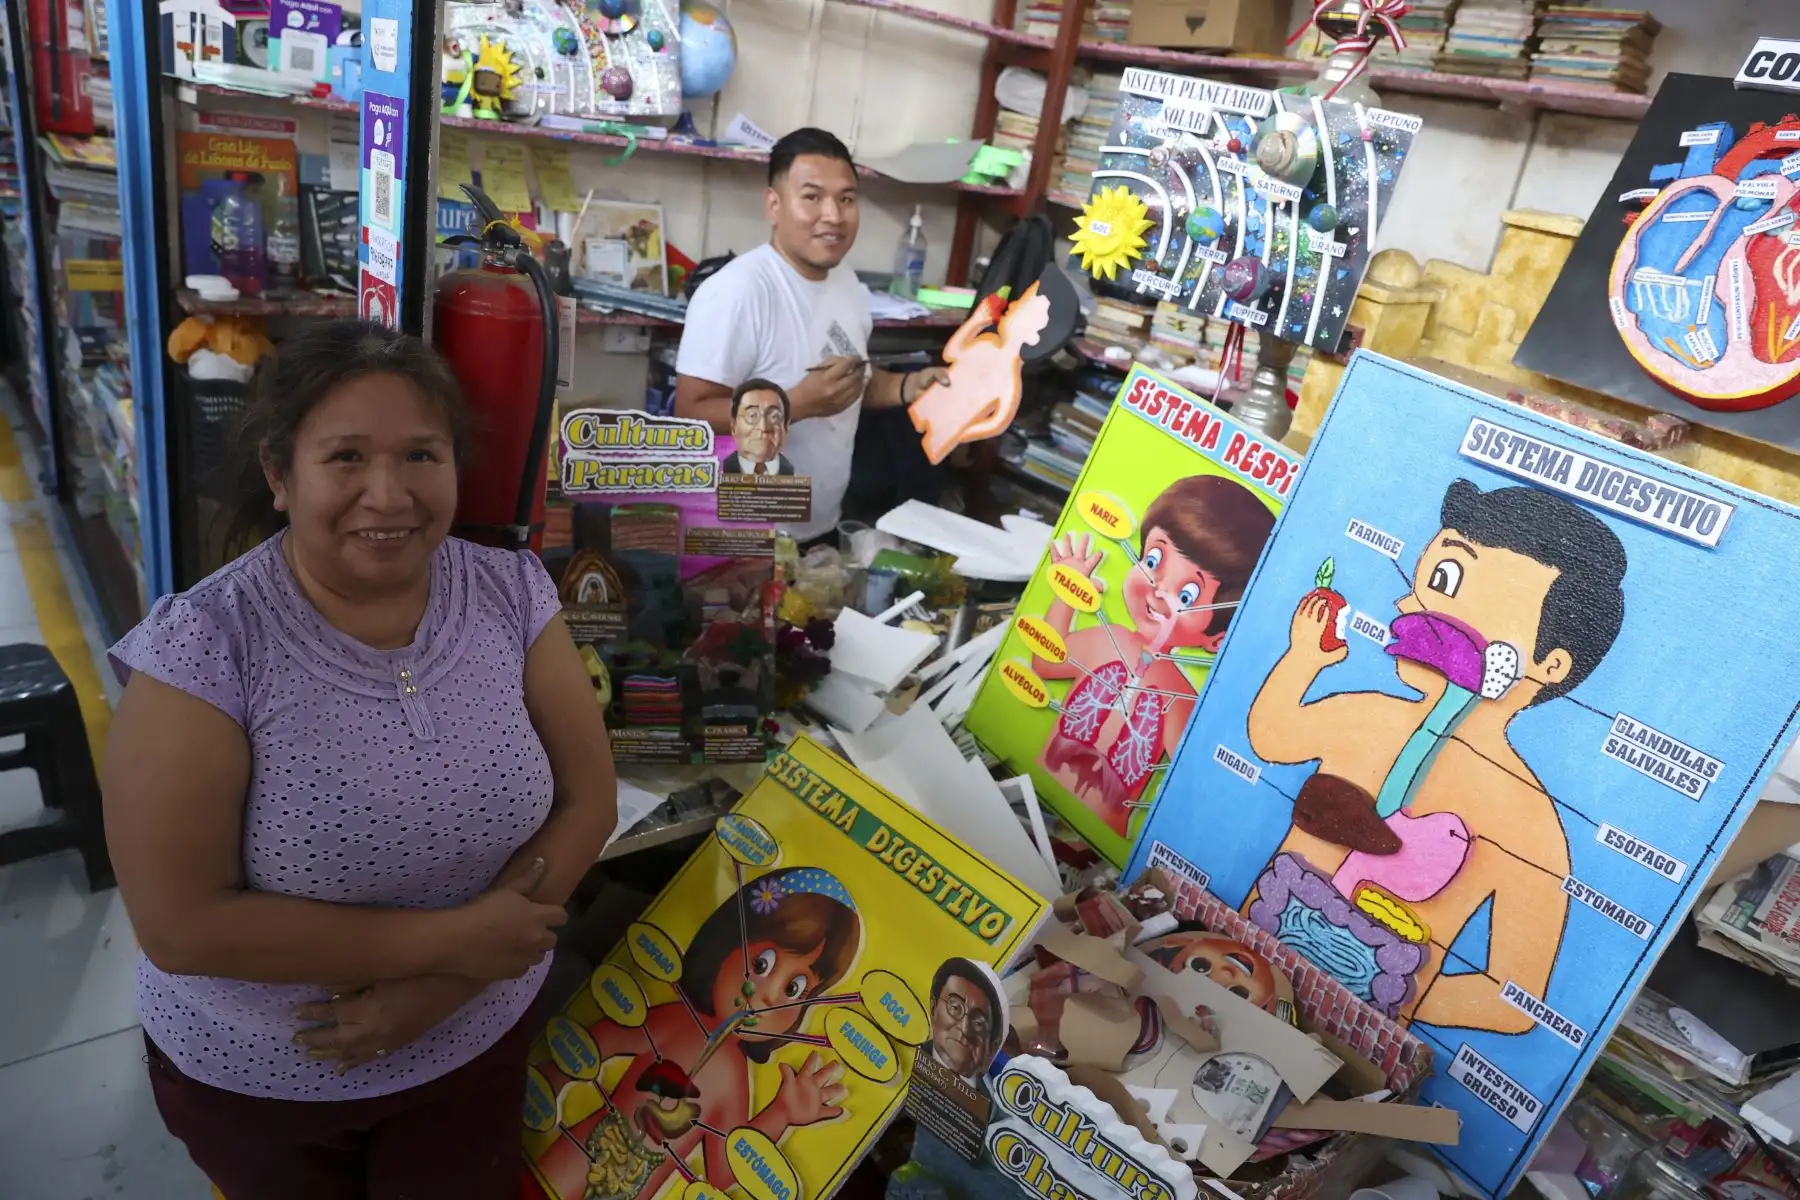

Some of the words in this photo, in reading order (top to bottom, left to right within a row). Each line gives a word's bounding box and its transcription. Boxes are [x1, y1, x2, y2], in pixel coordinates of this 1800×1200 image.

[1744, 50, 1800, 85] CO
[1124, 71, 1175, 95] SISTEMA
[1178, 80, 1266, 111] PLANETARIO
[1164, 106, 1205, 133] SOLAR
[1368, 111, 1420, 130] NEPTUNO
[1256, 180, 1300, 200] SATURNO
[1091, 222, 1109, 234] SOL
[1197, 245, 1226, 262] TIERRA
[1311, 239, 1345, 256] URANO
[1134, 271, 1180, 293] MERCURIO
[1232, 306, 1266, 322] JUPITER
[567, 415, 708, 449] Cultura
[566, 458, 713, 490] Paracas
[1466, 423, 1576, 485] SISTEMA
[1575, 464, 1722, 536] DIGESTIVO
[1090, 503, 1119, 528] NARIZ
[1348, 520, 1401, 555] FARINGE
[1054, 570, 1094, 606] TRÁQUEA
[1017, 618, 1066, 661] BRONQUIOS
[1353, 616, 1386, 642] BOCA
[1003, 664, 1046, 703] ALVÉOLOS
[1216, 747, 1256, 779] HIGADO
[1614, 717, 1719, 779] GLANDULAS
[1605, 738, 1701, 795] SALIVALES
[767, 753, 860, 833] SISTEMA
[866, 825, 1006, 940] DIGESTIVO
[1154, 843, 1207, 886] INTESTINO
[1563, 877, 1648, 936] ESTOMAGO
[879, 991, 911, 1028] BOCA
[839, 1020, 888, 1070] FARINGE
[1460, 1049, 1537, 1115] INTESTINO
[1462, 1071, 1519, 1121] GRUESO
[997, 1069, 1174, 1200] Cultura
[733, 1137, 791, 1200] ESTÓMAGO
[993, 1129, 1090, 1200] Cha
